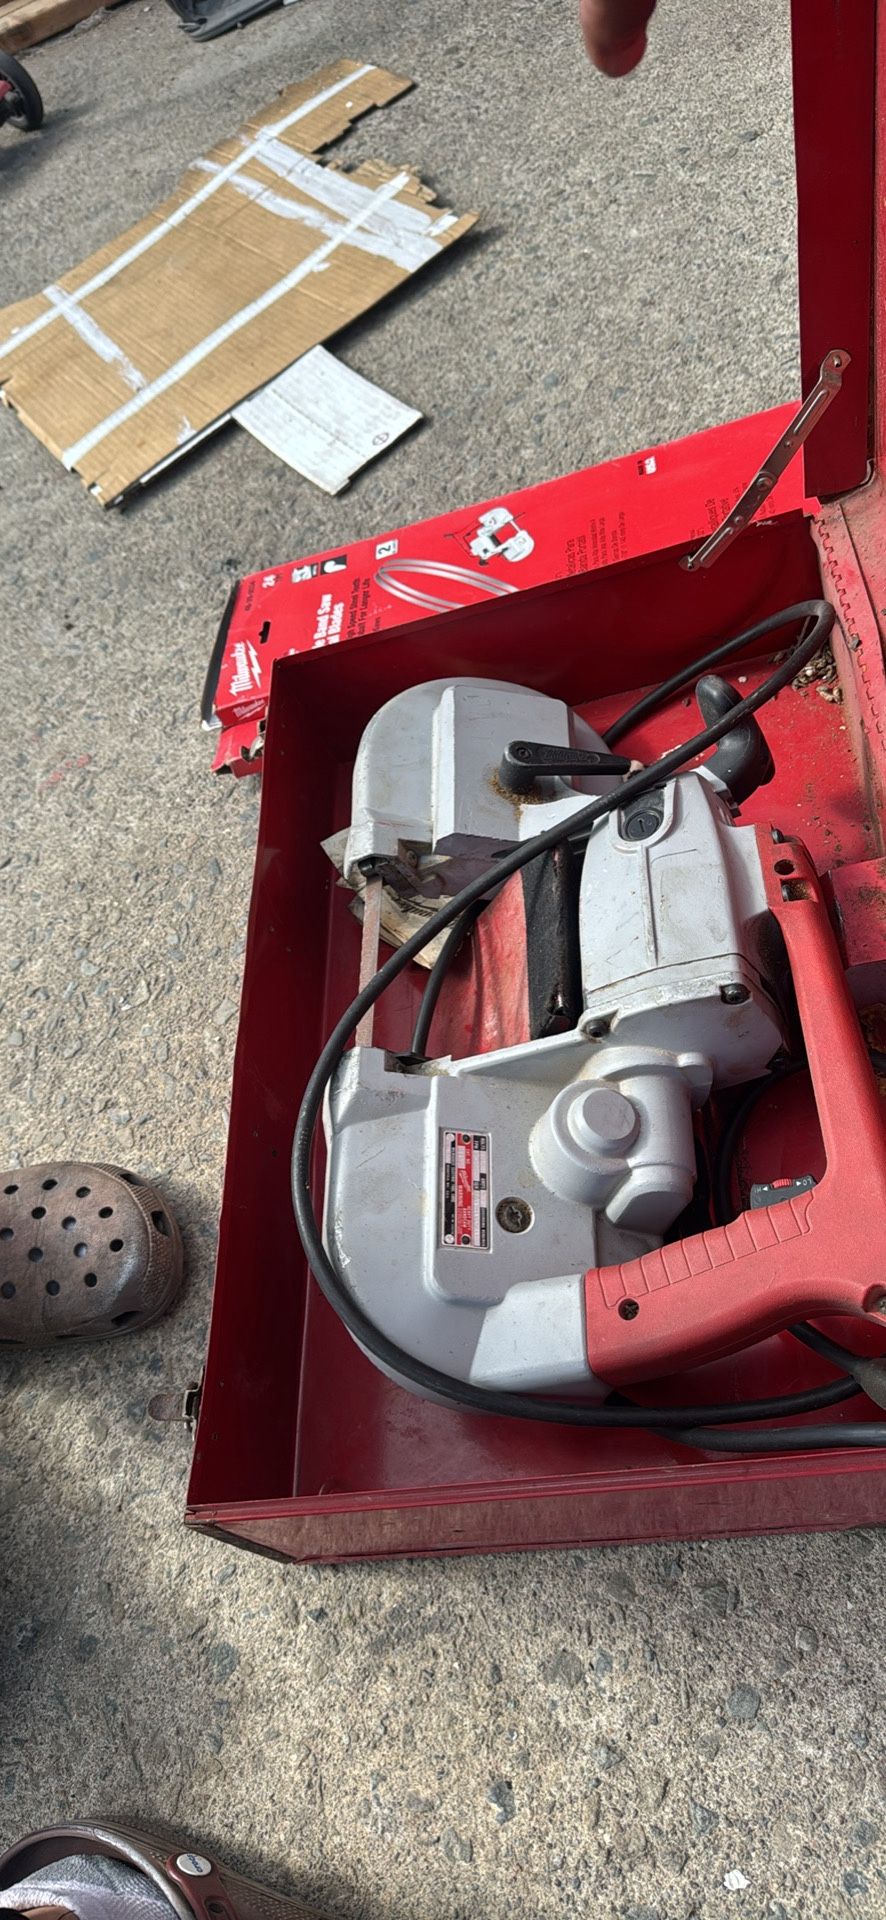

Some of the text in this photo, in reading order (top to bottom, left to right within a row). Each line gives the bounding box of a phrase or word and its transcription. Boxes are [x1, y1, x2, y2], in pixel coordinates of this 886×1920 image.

[378, 545, 391, 554] 2
[262, 575, 276, 588] 24
[317, 594, 332, 615] Saw
[313, 615, 329, 640] Band
[328, 602, 344, 634] Blades
[228, 641, 254, 696] Milwaukee
[802, 1178, 812, 1186] LO
